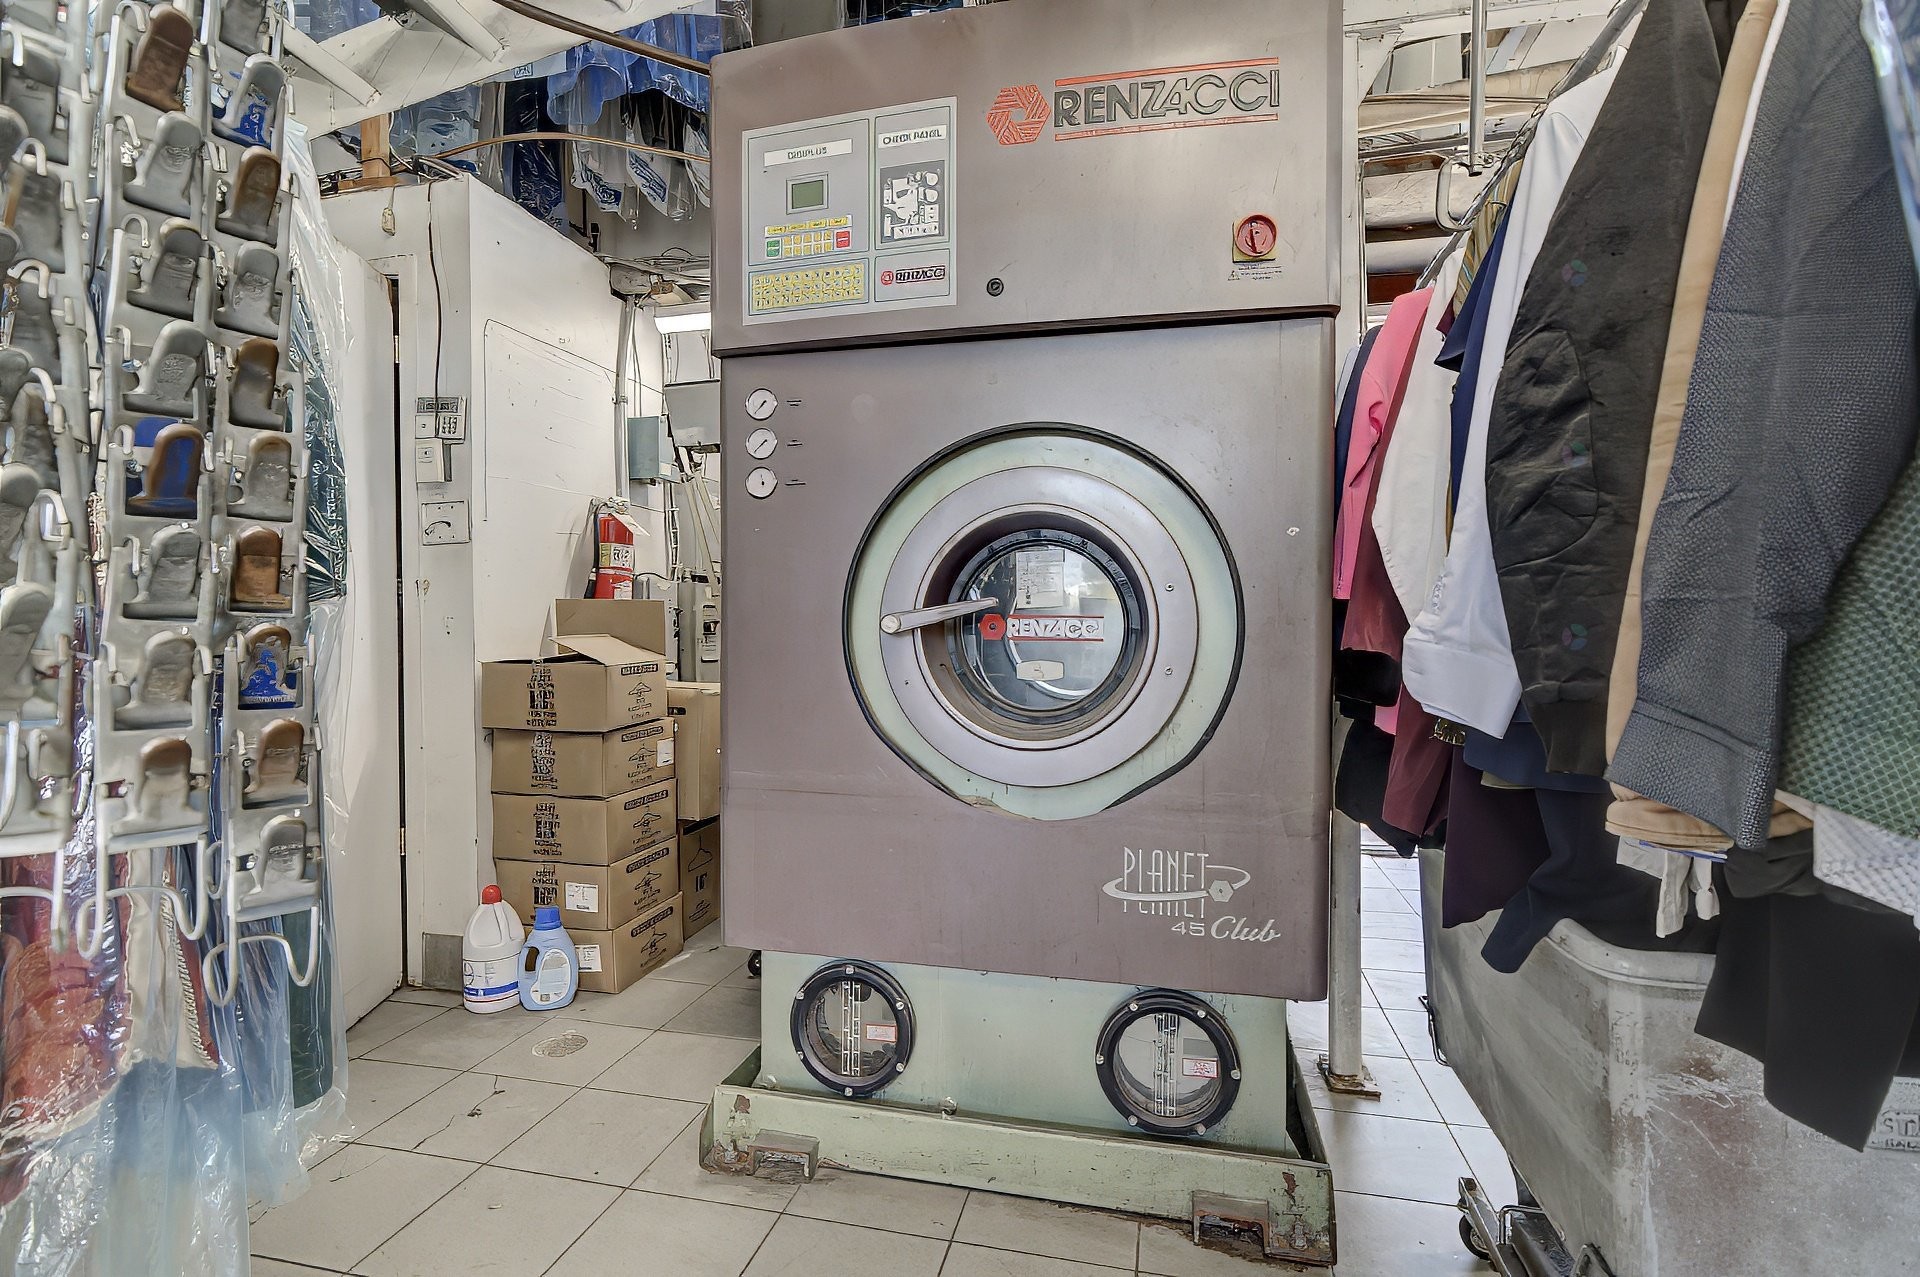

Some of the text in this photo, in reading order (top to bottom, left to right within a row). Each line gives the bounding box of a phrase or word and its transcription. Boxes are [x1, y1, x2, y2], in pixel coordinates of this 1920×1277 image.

[1053, 69, 1280, 128] RENZACCI
[1123, 846, 1210, 919] PLANET
[1171, 915, 1282, 943] 45 Club
